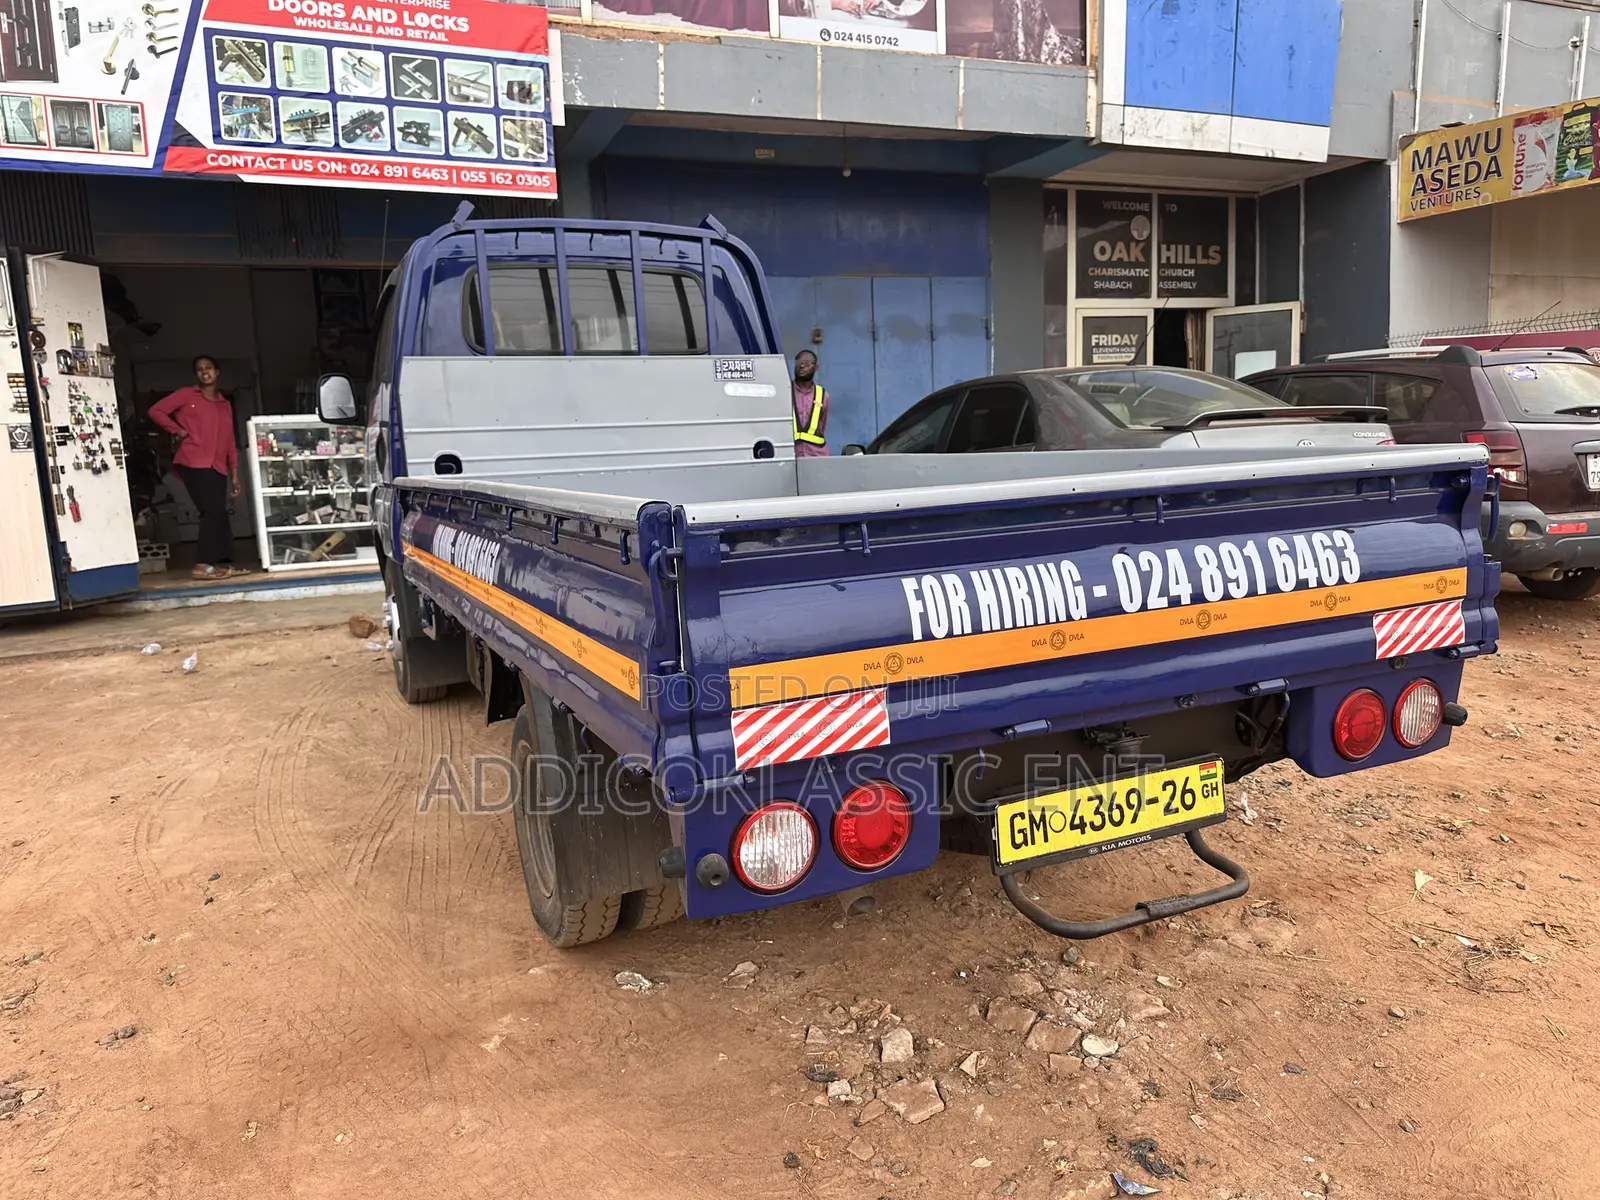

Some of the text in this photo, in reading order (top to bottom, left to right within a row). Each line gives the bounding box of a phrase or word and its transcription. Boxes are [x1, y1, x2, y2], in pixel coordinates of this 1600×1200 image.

[268, 0, 469, 32] DOORS AND LOCKS
[293, 16, 448, 42] WHOLESALE AND RETAIL
[834, 31, 899, 47] 024 415 0742
[1411, 127, 1503, 173] MAWU
[206, 153, 287, 170] CONTACT
[291, 159, 314, 172] US
[317, 160, 347, 174] ON:
[350, 162, 380, 176] 024
[383, 164, 408, 178] 891
[411, 167, 449, 181] 6463
[460, 170, 487, 183] 055
[489, 171, 513, 185] 162
[516, 173, 550, 187] 0305
[1410, 155, 1503, 198] ASEDA
[1102, 200, 1177, 213] WELCOME TO
[1410, 186, 1481, 212] VENTURES
[1093, 240, 1222, 266] OAK HILLS
[1088, 267, 1195, 278] CHARISMATIC CHURCH
[1093, 280, 1198, 290] SHABACH ASSEMBLY
[1091, 333, 1139, 347] FRIDAY
[901, 574, 973, 641] FOR
[969, 559, 1087, 632] HIRING
[1111, 548, 1192, 614] 024
[1194, 540, 1267, 603] 891
[1267, 529, 1361, 593] 6463
[863, 661, 882, 671] DVLA
[906, 655, 924, 665] DVLA
[1031, 638, 1048, 647] DVLA
[1068, 632, 1085, 642] DVLA
[1179, 617, 1194, 626] DVLA
[1213, 612, 1228, 621] DVLA
[1069, 776, 1196, 835] 4369-26
[1201, 781, 1219, 799] GH
[1101, 843, 1117, 851] KIA
[1118, 834, 1152, 848] MOTORS
